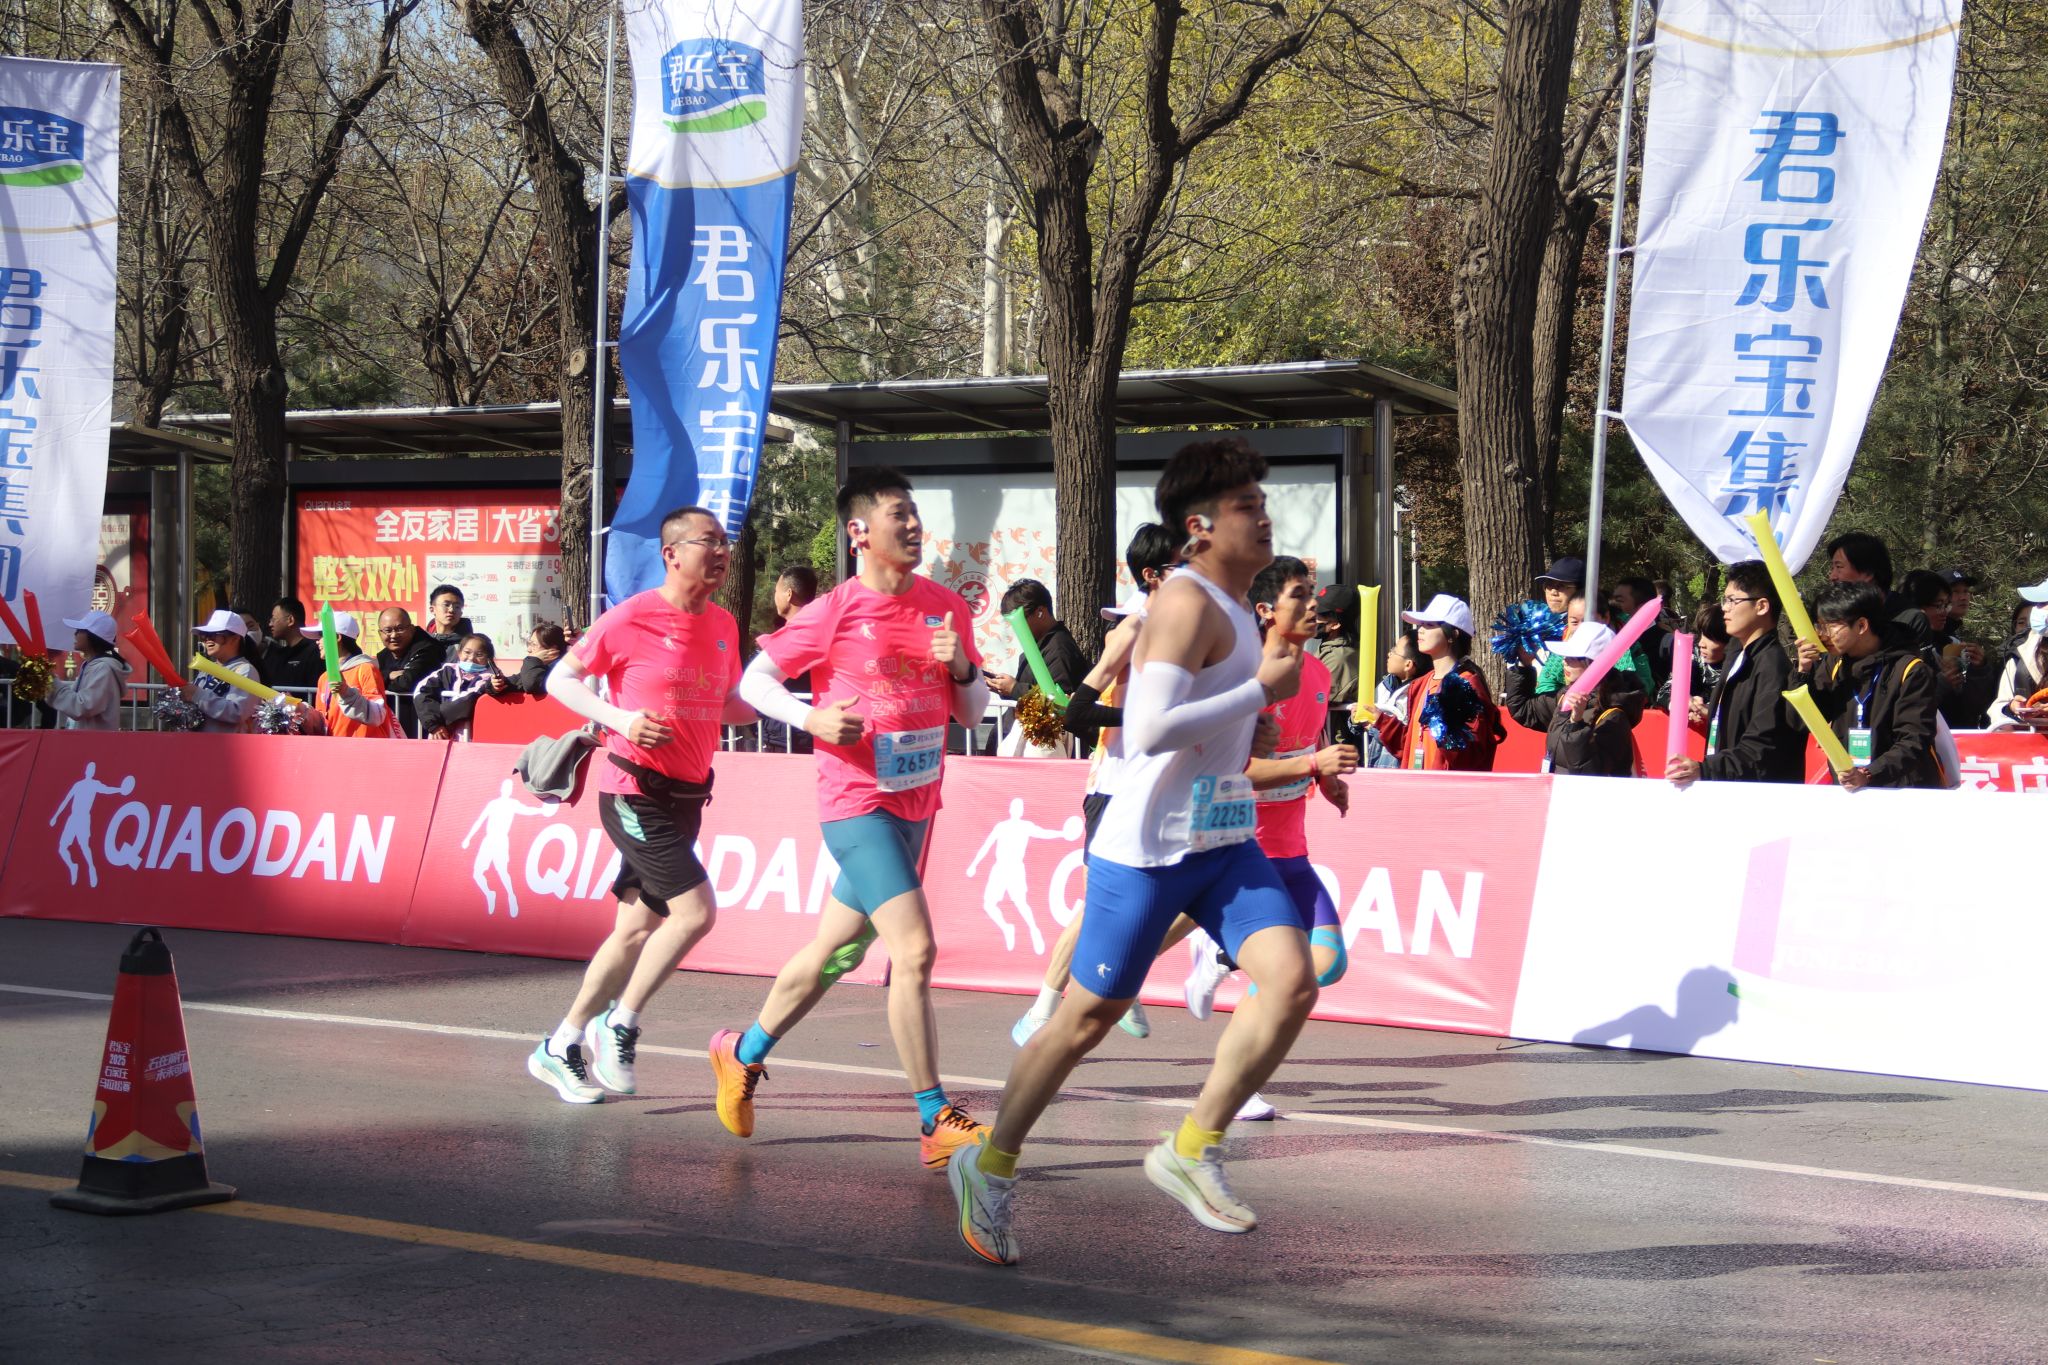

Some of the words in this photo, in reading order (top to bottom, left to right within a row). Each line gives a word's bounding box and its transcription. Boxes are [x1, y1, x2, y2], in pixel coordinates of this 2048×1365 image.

[669, 50, 751, 94] 君乐宝
[1719, 110, 1847, 548] 君乐宝集
[374, 509, 479, 543] 全友家居
[312, 555, 419, 602] 整家双补
[663, 666, 697, 682] SHI
[864, 657, 898, 676] SHI
[1210, 803, 1254, 828] 22251
[103, 801, 396, 884] QIAODAN
[105, 1066, 129, 1079] 石家庄
[109, 1055, 126, 1066] 2025
